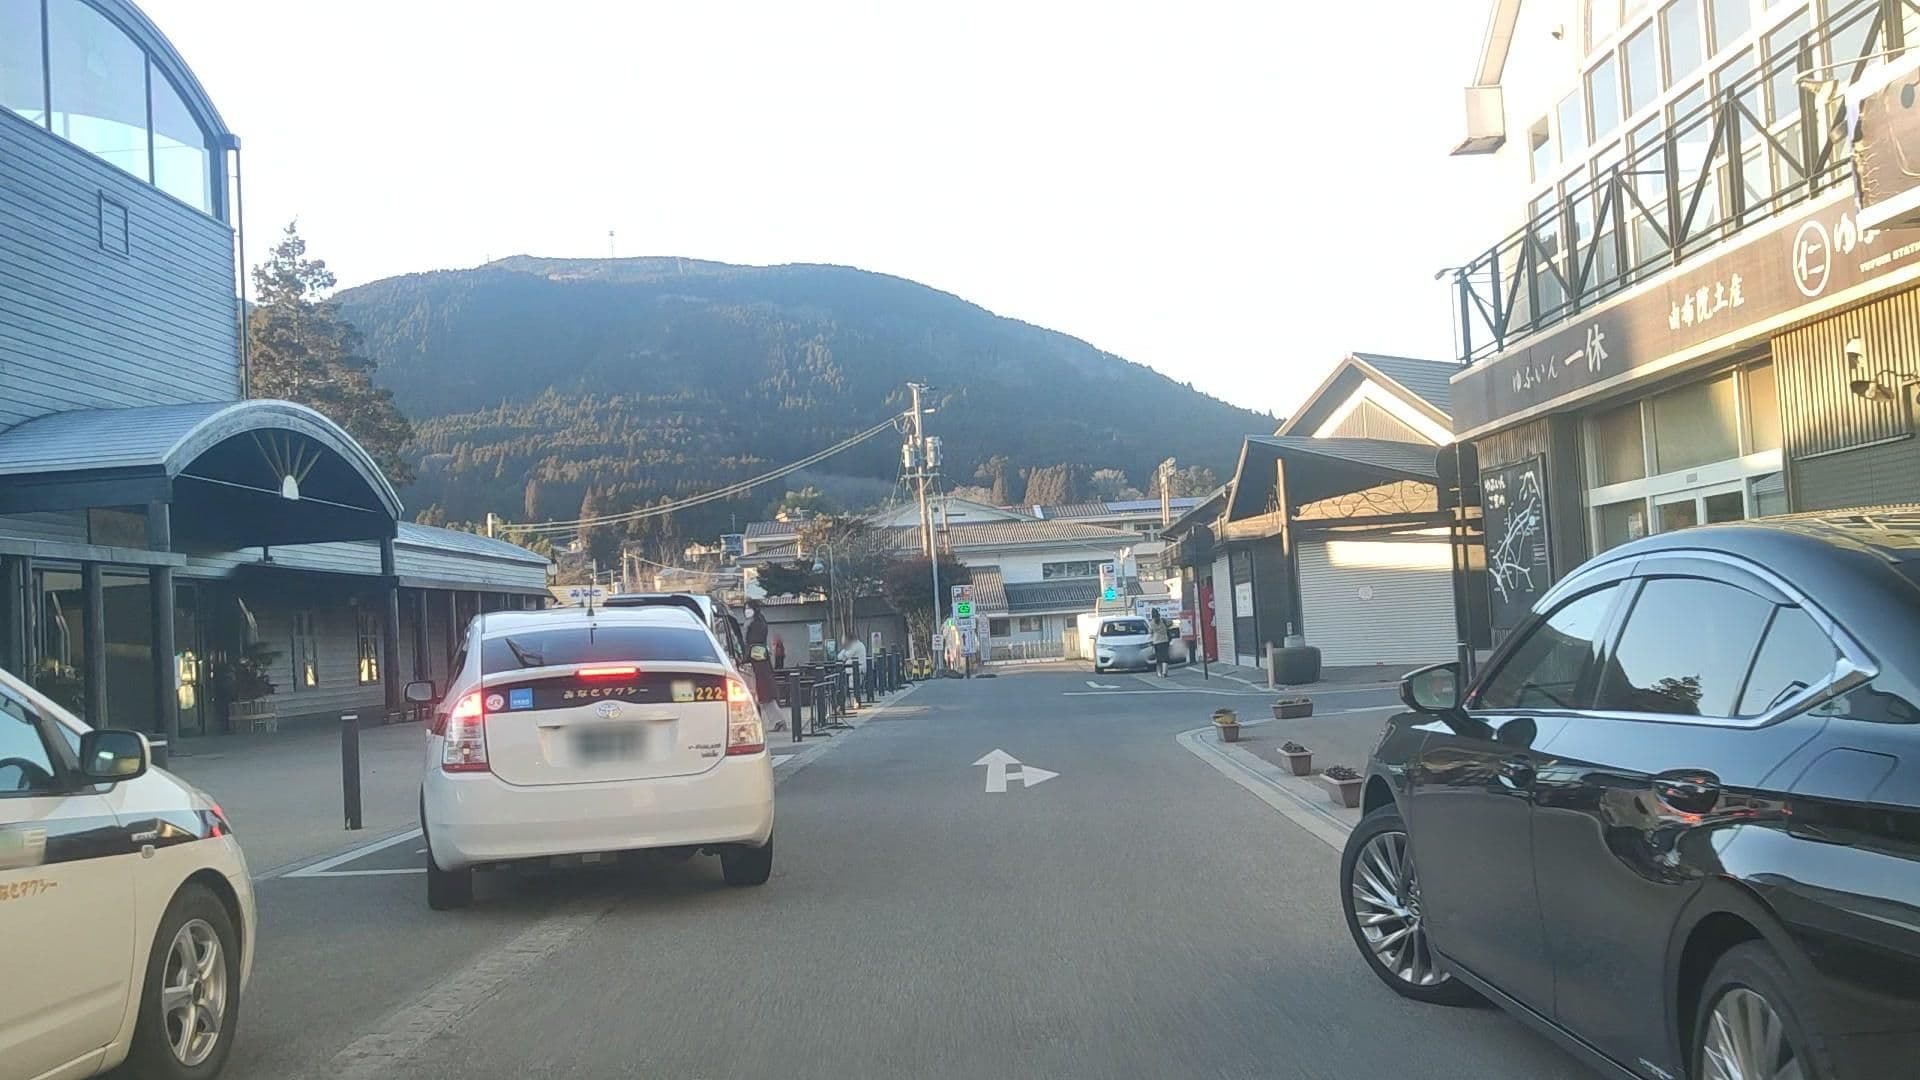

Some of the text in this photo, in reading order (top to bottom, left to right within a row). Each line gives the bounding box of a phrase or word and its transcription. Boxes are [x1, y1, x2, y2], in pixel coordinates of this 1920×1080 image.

[1668, 273, 1745, 330] 由布院土産
[1512, 323, 1609, 393] ゆふいん 一休
[563, 686, 649, 700] みなとタクシー
[696, 687, 723, 700] 222
